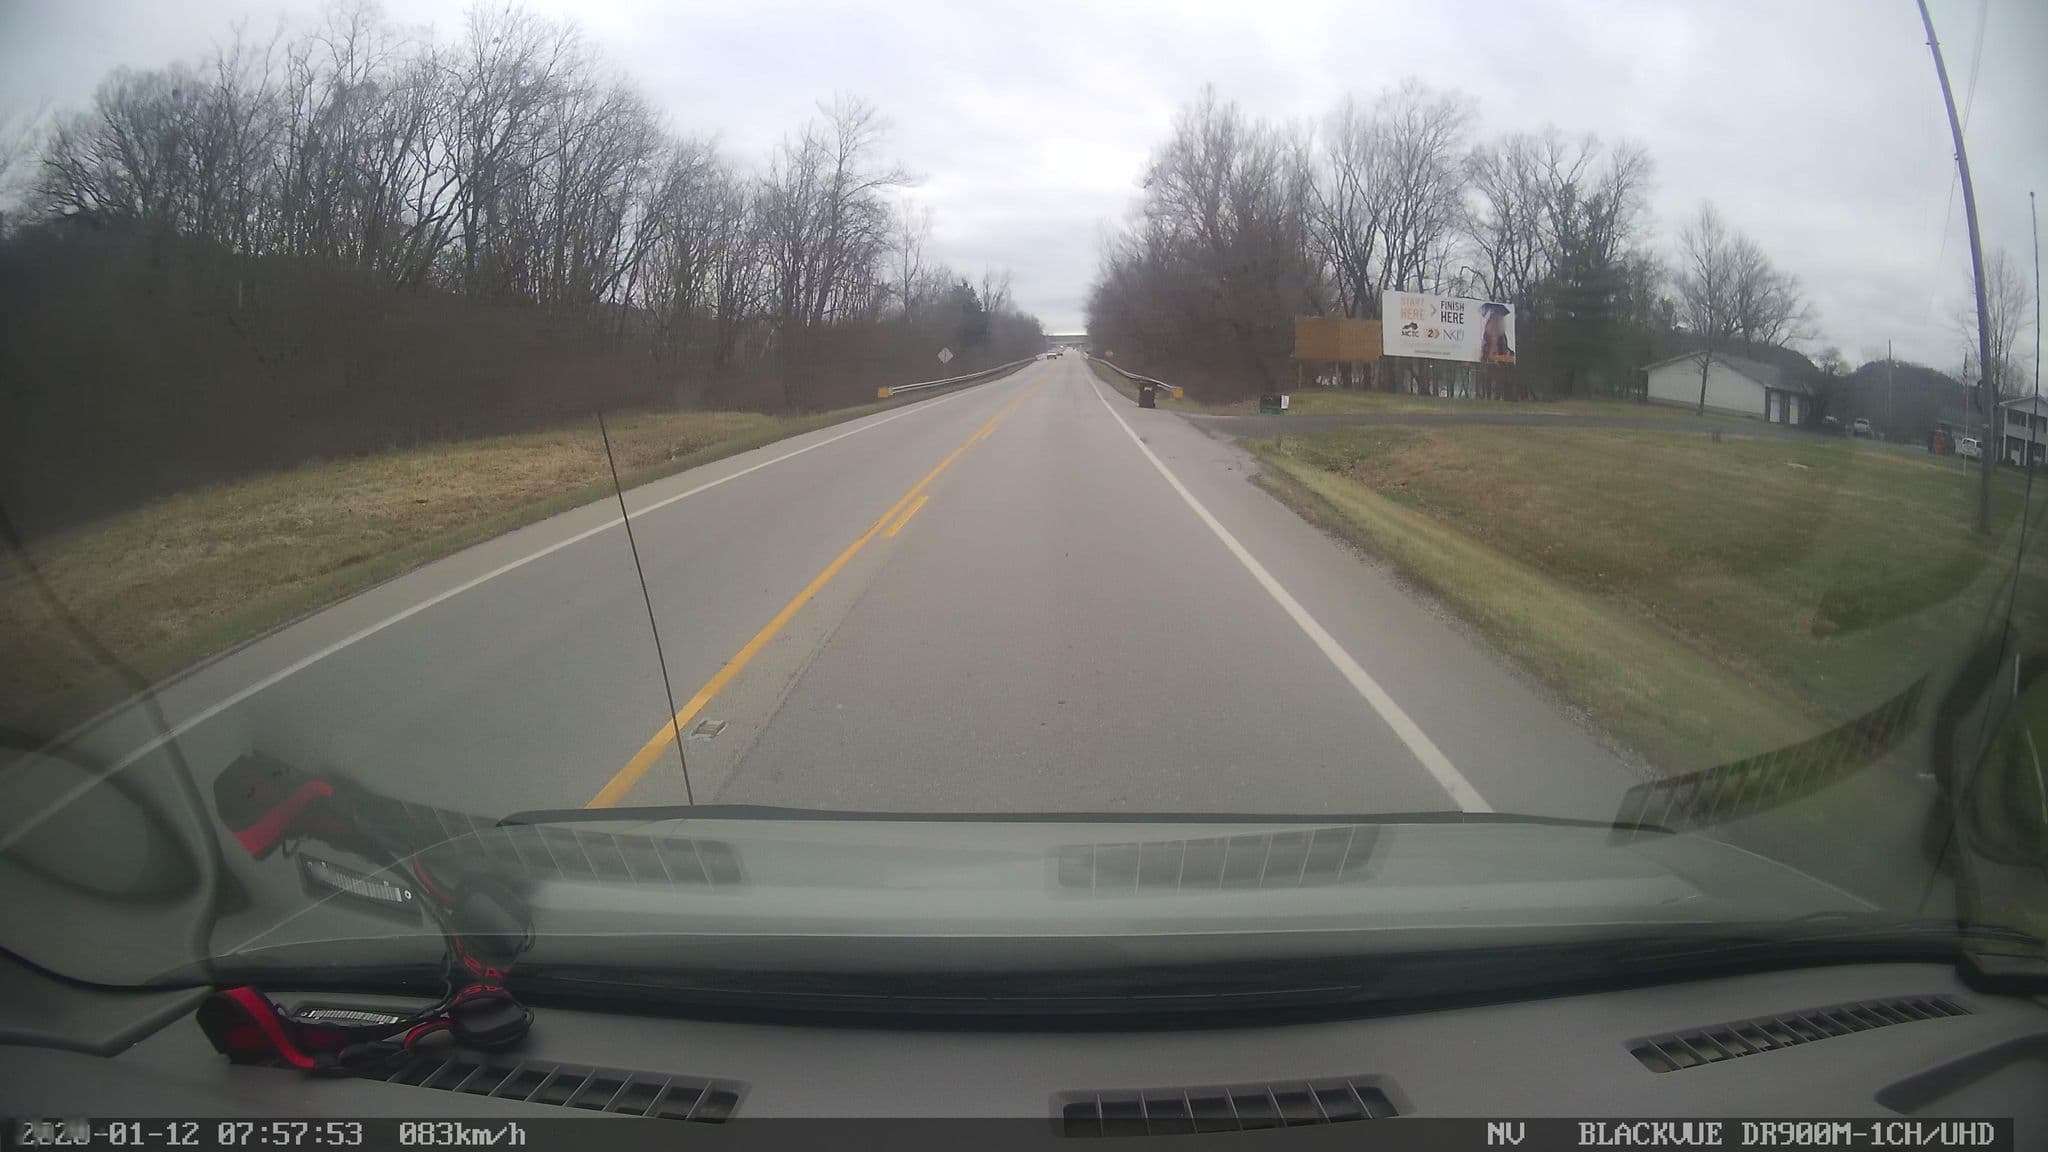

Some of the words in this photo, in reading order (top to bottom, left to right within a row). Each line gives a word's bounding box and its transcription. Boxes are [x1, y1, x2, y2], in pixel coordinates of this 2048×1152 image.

[1440, 301, 1464, 312] FINISH
[1401, 307, 1424, 320] HERE
[1440, 311, 1464, 324] HERE
